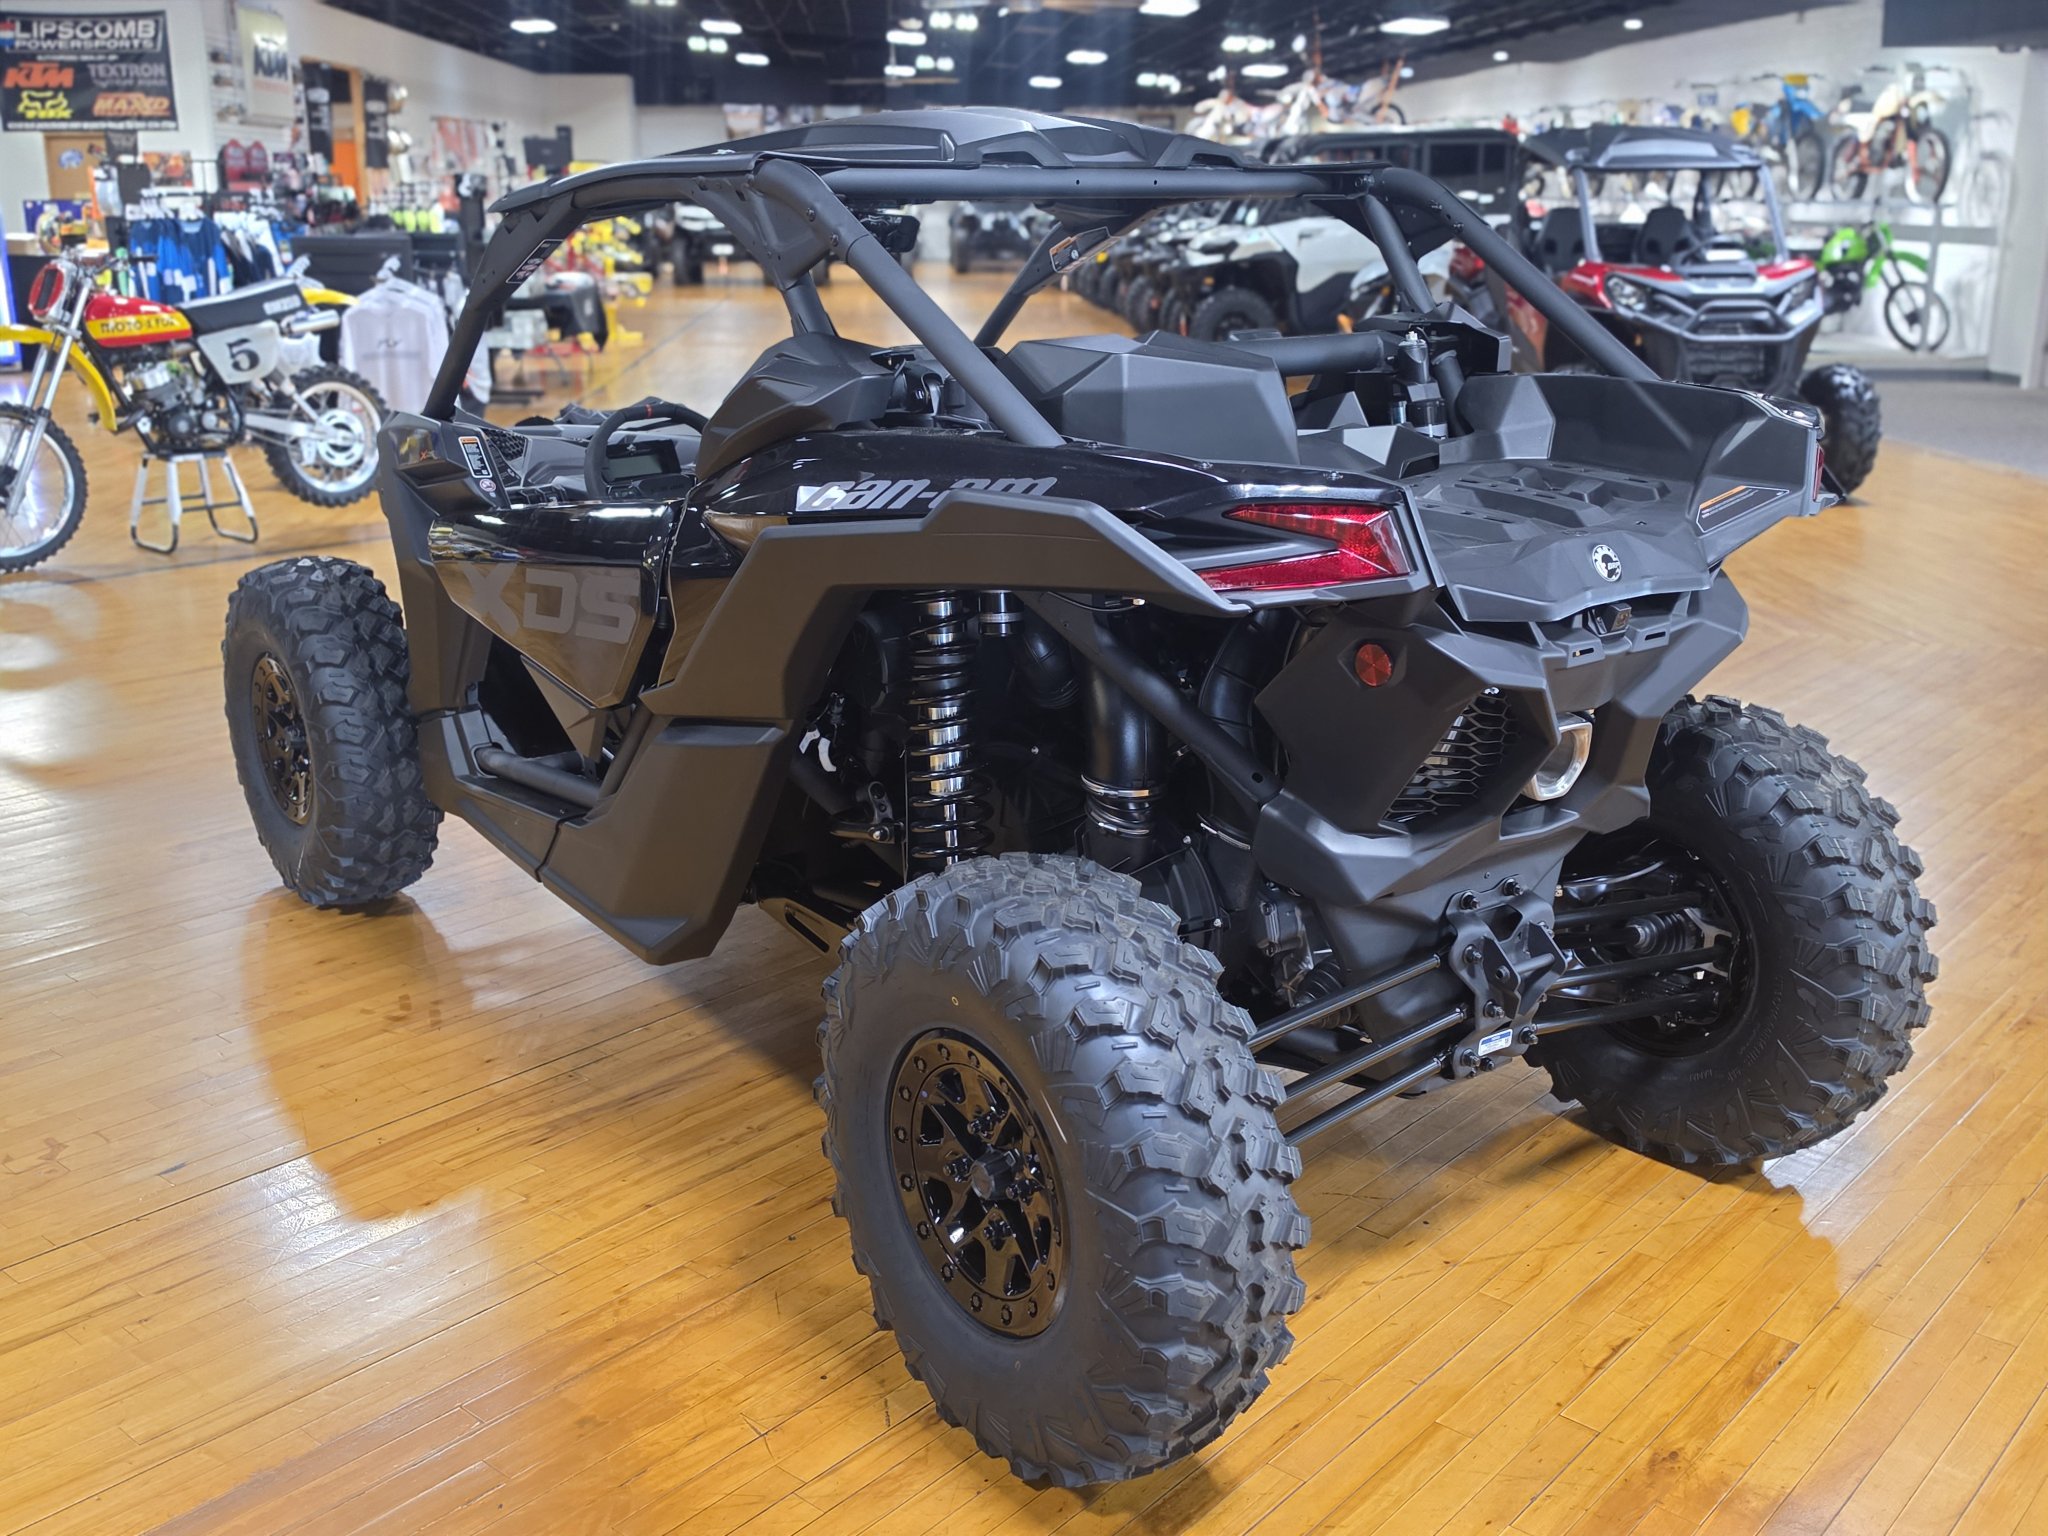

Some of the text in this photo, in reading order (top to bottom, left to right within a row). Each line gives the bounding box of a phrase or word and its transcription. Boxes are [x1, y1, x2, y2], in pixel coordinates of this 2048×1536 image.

[15, 19, 156, 40] LIPSCOMB
[15, 38, 154, 50] POWERSPORTS
[4, 62, 75, 89] KTM
[87, 63, 167, 79] TEXTRON
[226, 337, 260, 372] 5
[457, 560, 641, 645] XDS
